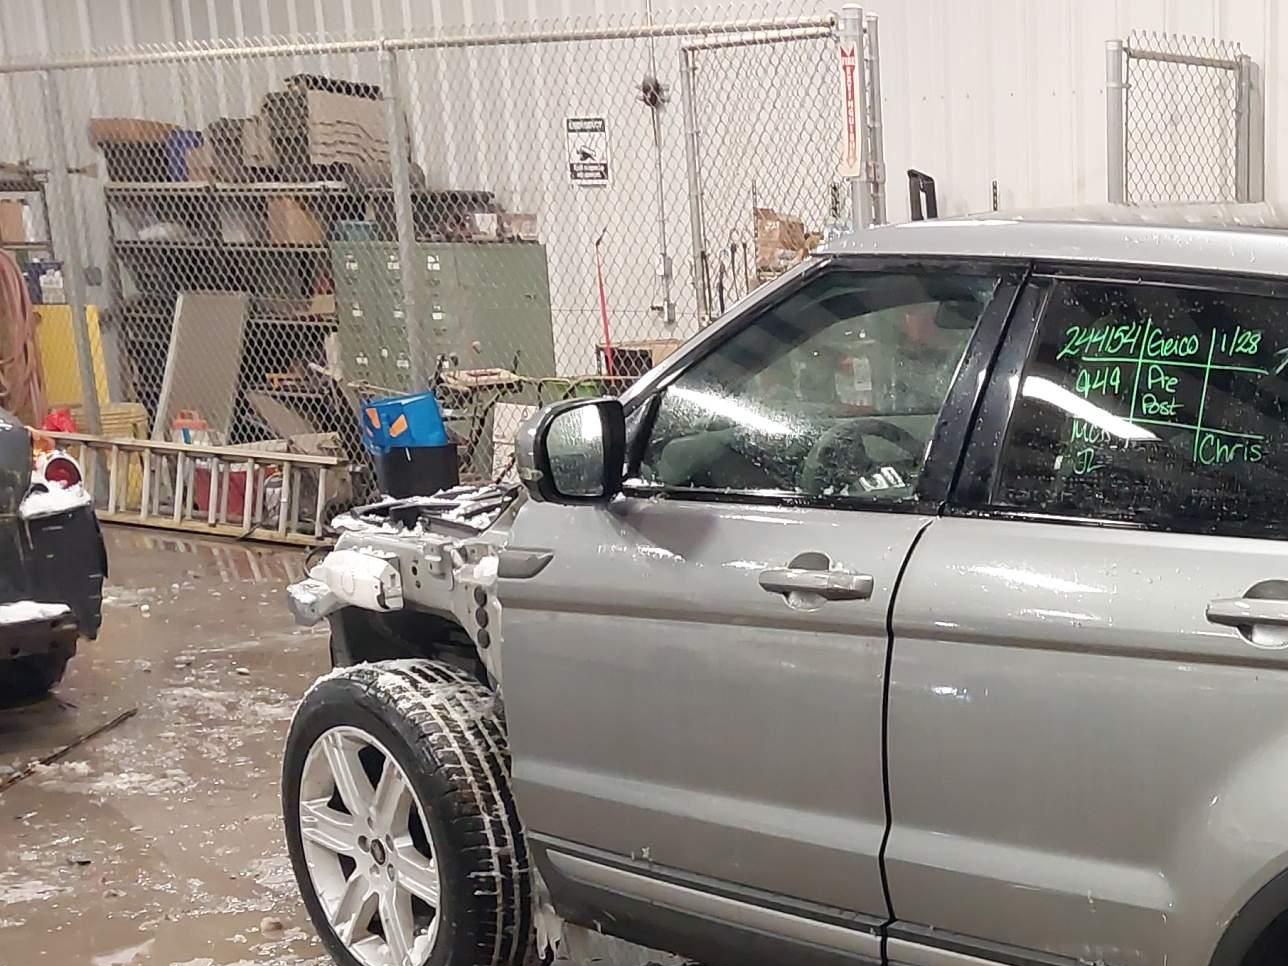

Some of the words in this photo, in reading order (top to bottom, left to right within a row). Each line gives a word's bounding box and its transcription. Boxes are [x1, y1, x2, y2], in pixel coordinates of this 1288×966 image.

[1057, 326, 1139, 360] 244154
[1147, 326, 1200, 357] Geico
[1220, 326, 1262, 357] 1/28
[1141, 394, 1185, 416] Post
[1199, 433, 1263, 465] Chris
